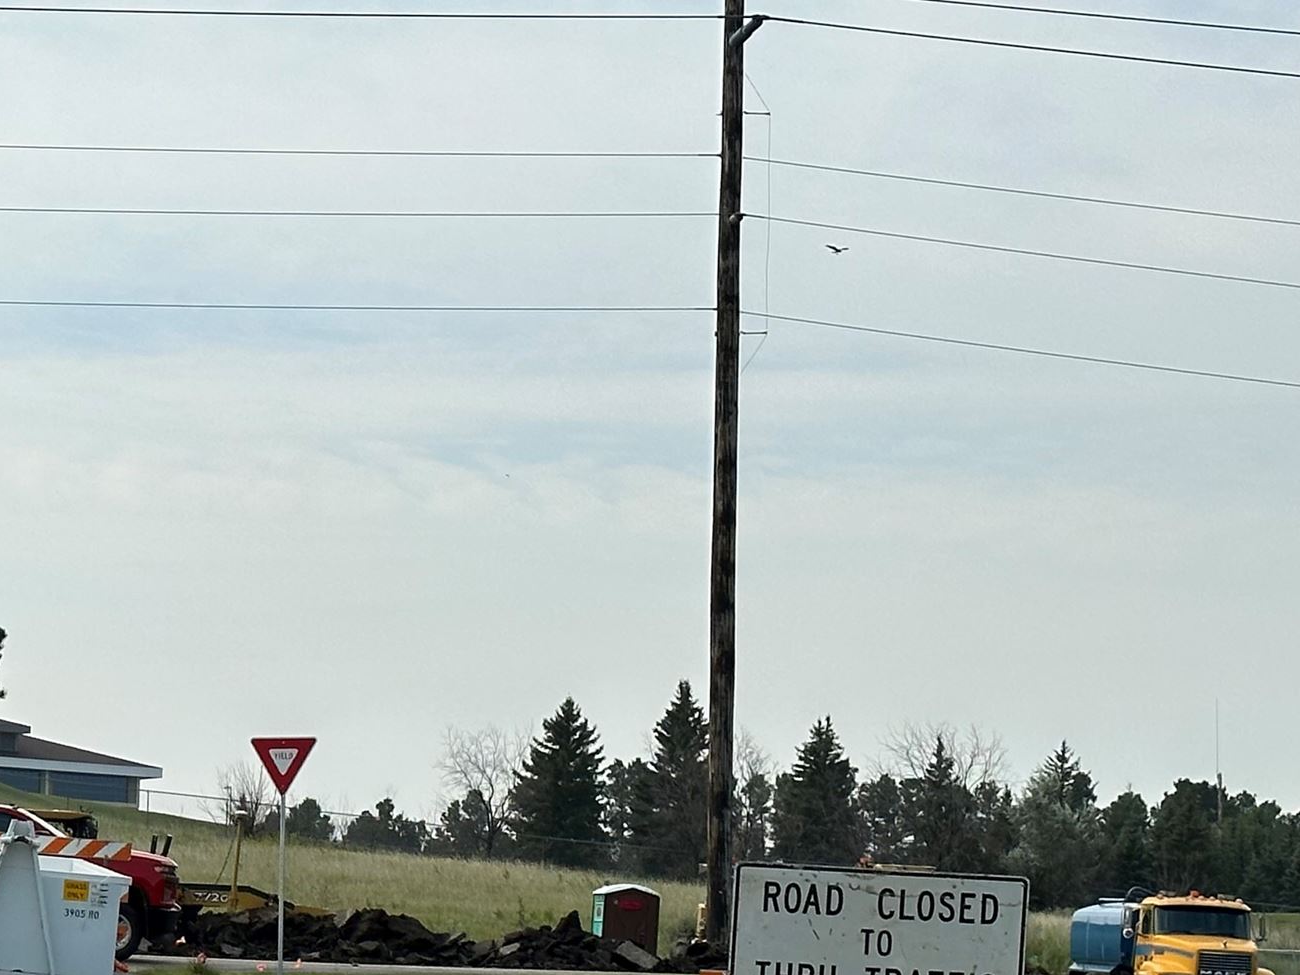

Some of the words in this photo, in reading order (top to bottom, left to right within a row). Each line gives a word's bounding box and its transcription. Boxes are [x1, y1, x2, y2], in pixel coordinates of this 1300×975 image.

[63, 908, 86, 919] 3905
[762, 880, 844, 916] ROAD
[877, 887, 1000, 925] CLOSED
[860, 928, 893, 957] TO
